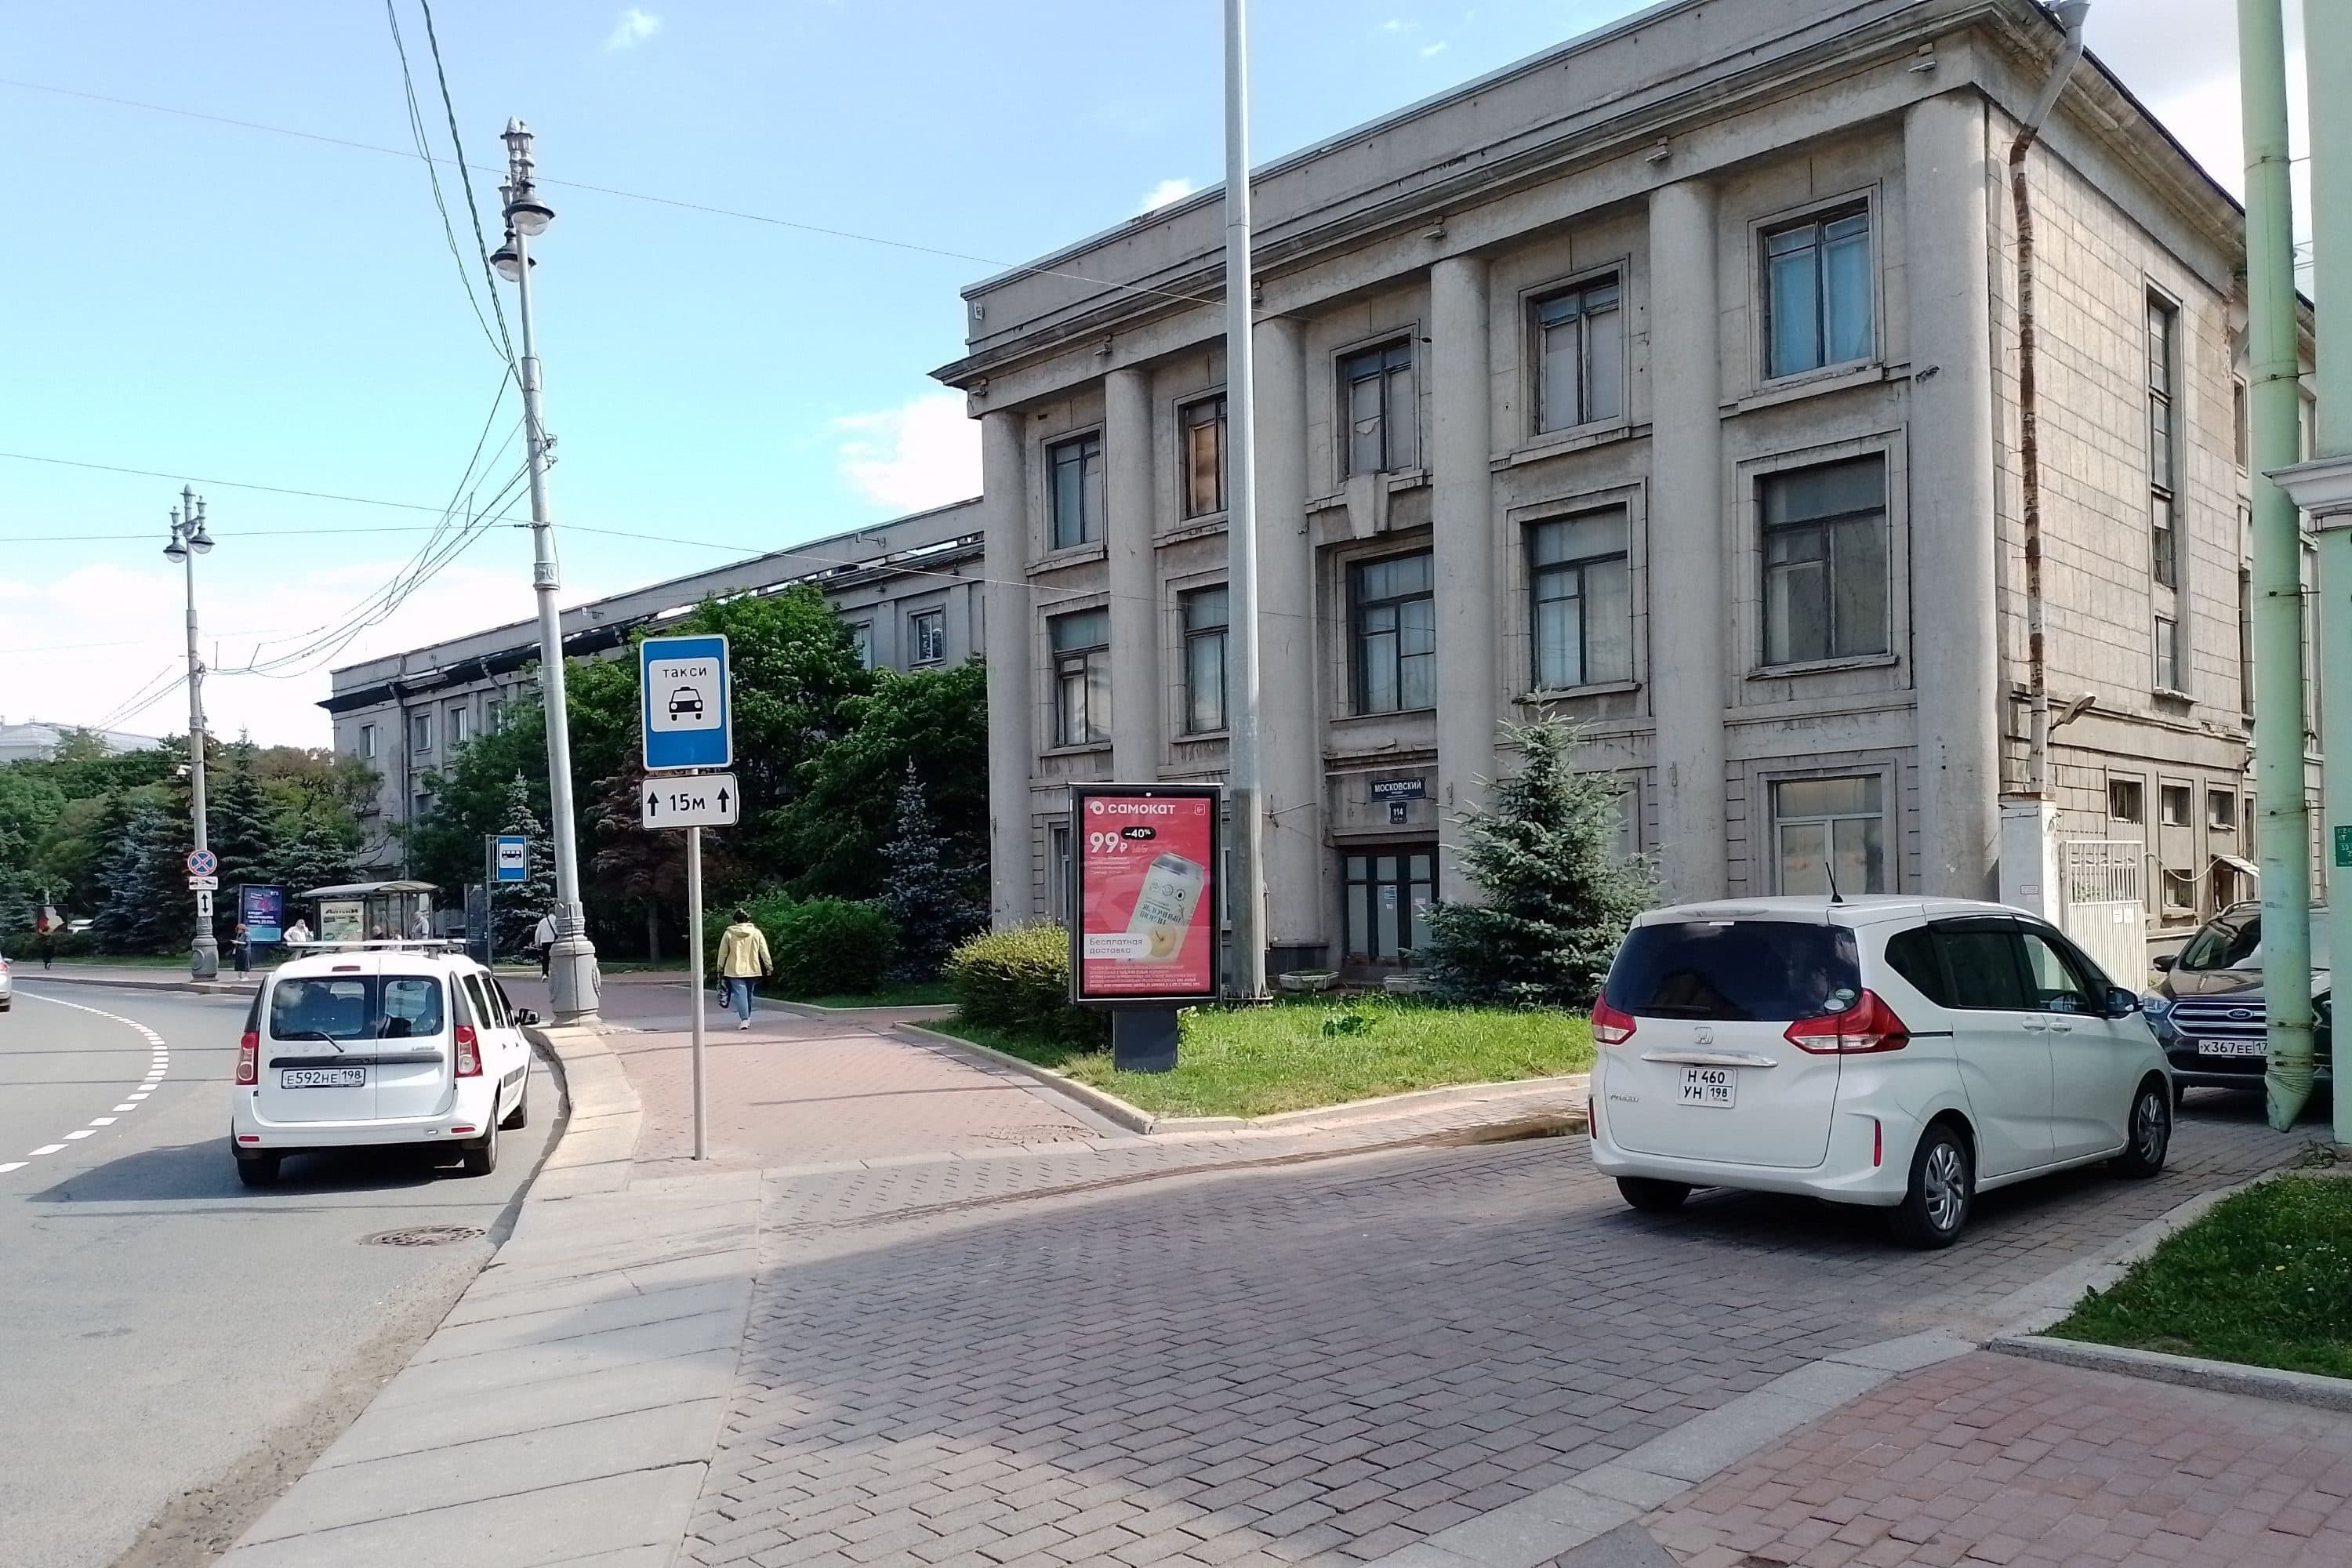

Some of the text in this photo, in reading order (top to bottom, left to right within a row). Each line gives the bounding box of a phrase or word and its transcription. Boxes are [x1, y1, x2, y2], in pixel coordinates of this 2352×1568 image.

[662, 667, 707, 678] такси
[1374, 779, 1421, 792] МОСКОВСКИЙ
[670, 793, 706, 811] 15м
[1392, 808, 1403, 816] 114
[341, 1070, 361, 1080] 198
[1710, 1087, 1728, 1098] 198
